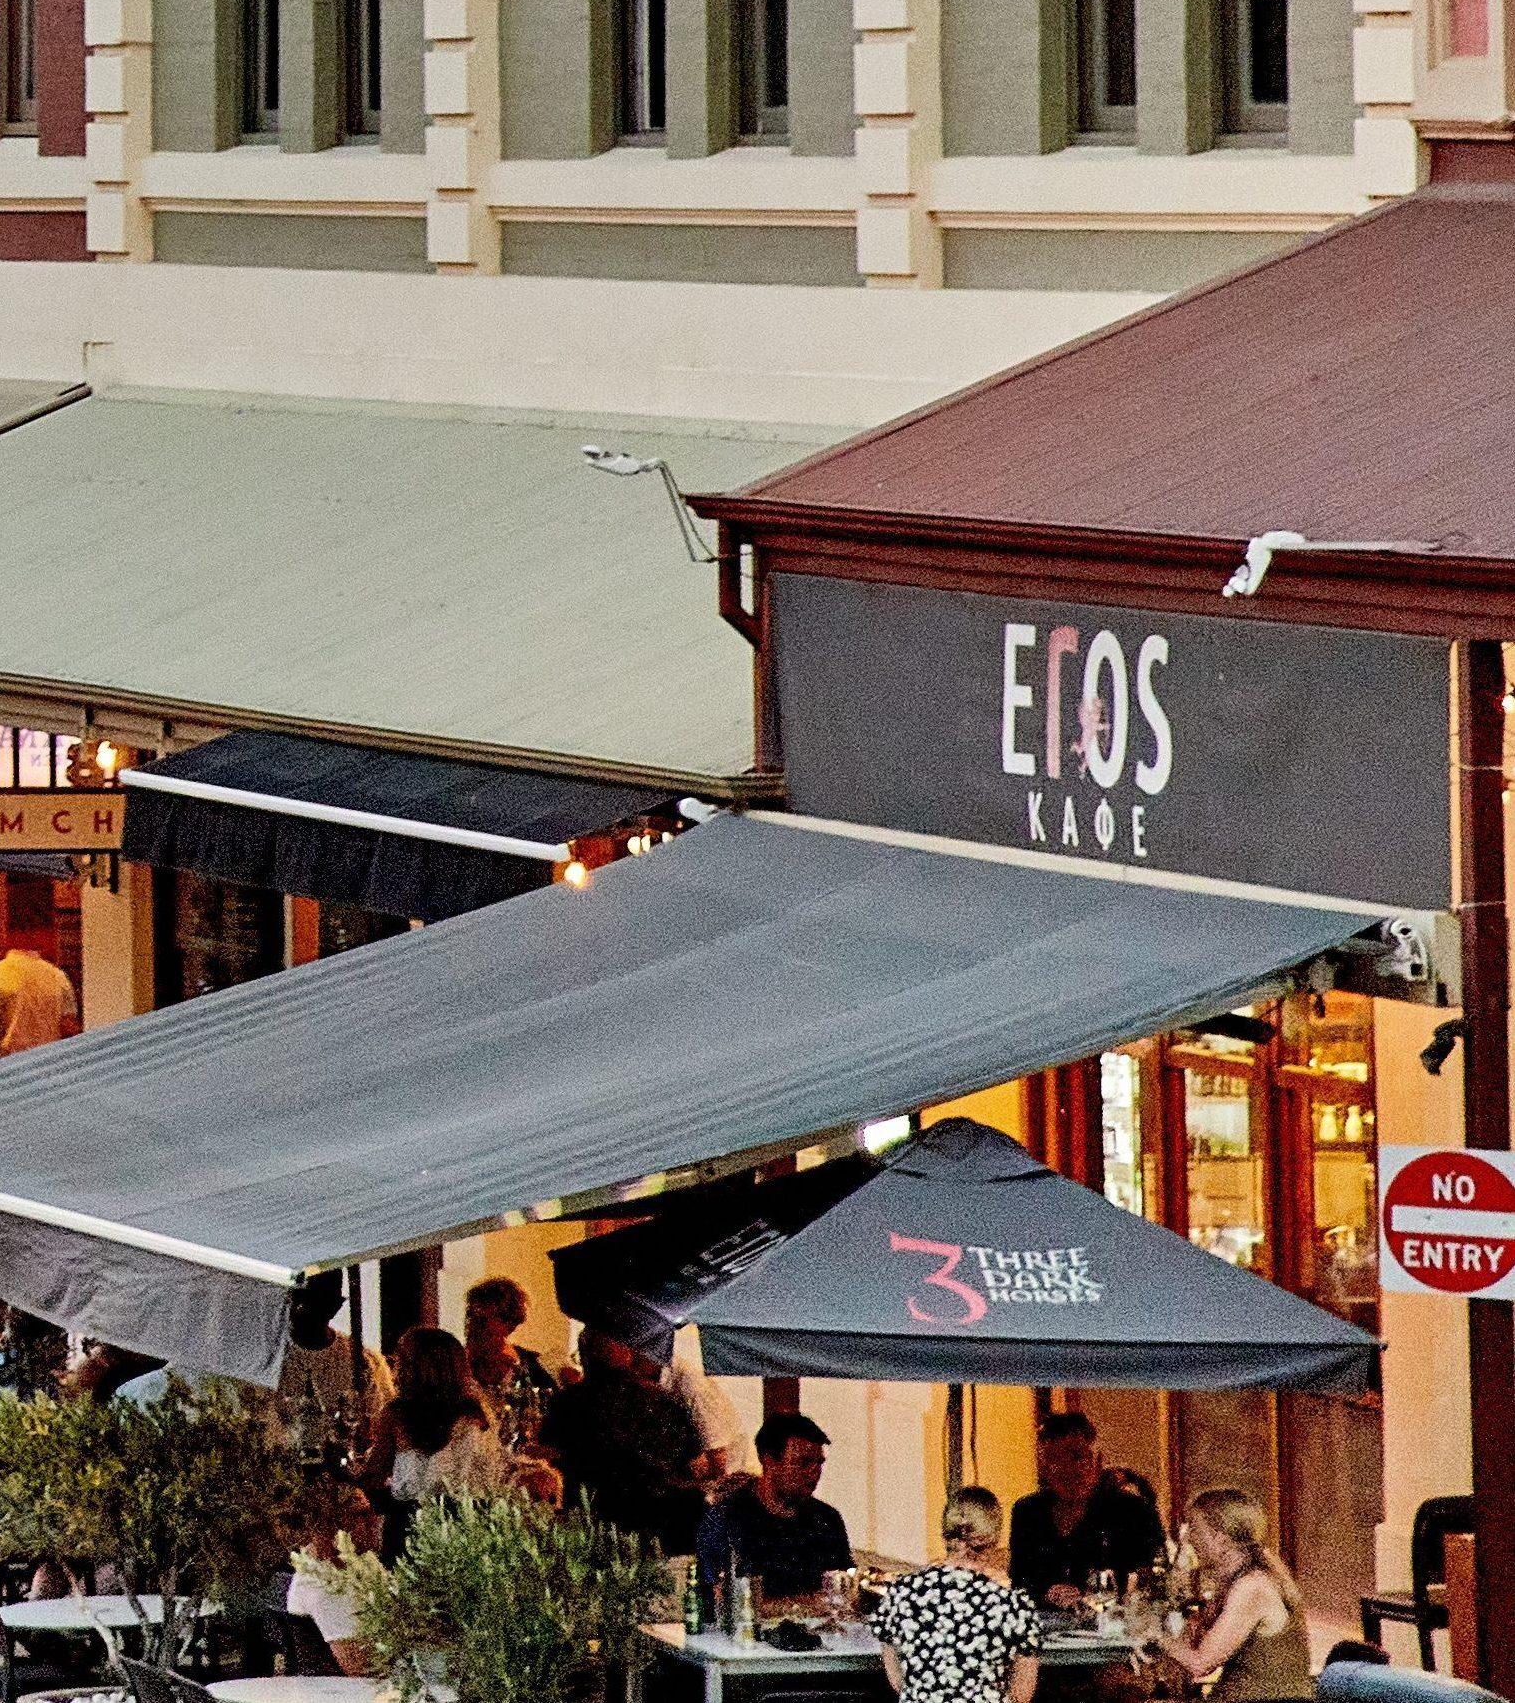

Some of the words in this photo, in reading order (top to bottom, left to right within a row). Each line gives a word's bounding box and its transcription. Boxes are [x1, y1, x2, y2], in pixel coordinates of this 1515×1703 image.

[1431, 1171, 1476, 1204] NO
[1403, 1238, 1505, 1273] ENTRY
[889, 1231, 988, 1325] 3
[967, 1247, 1089, 1270] THREE
[982, 1268, 1104, 1289] DARK
[988, 1289, 1101, 1304] HORSES
